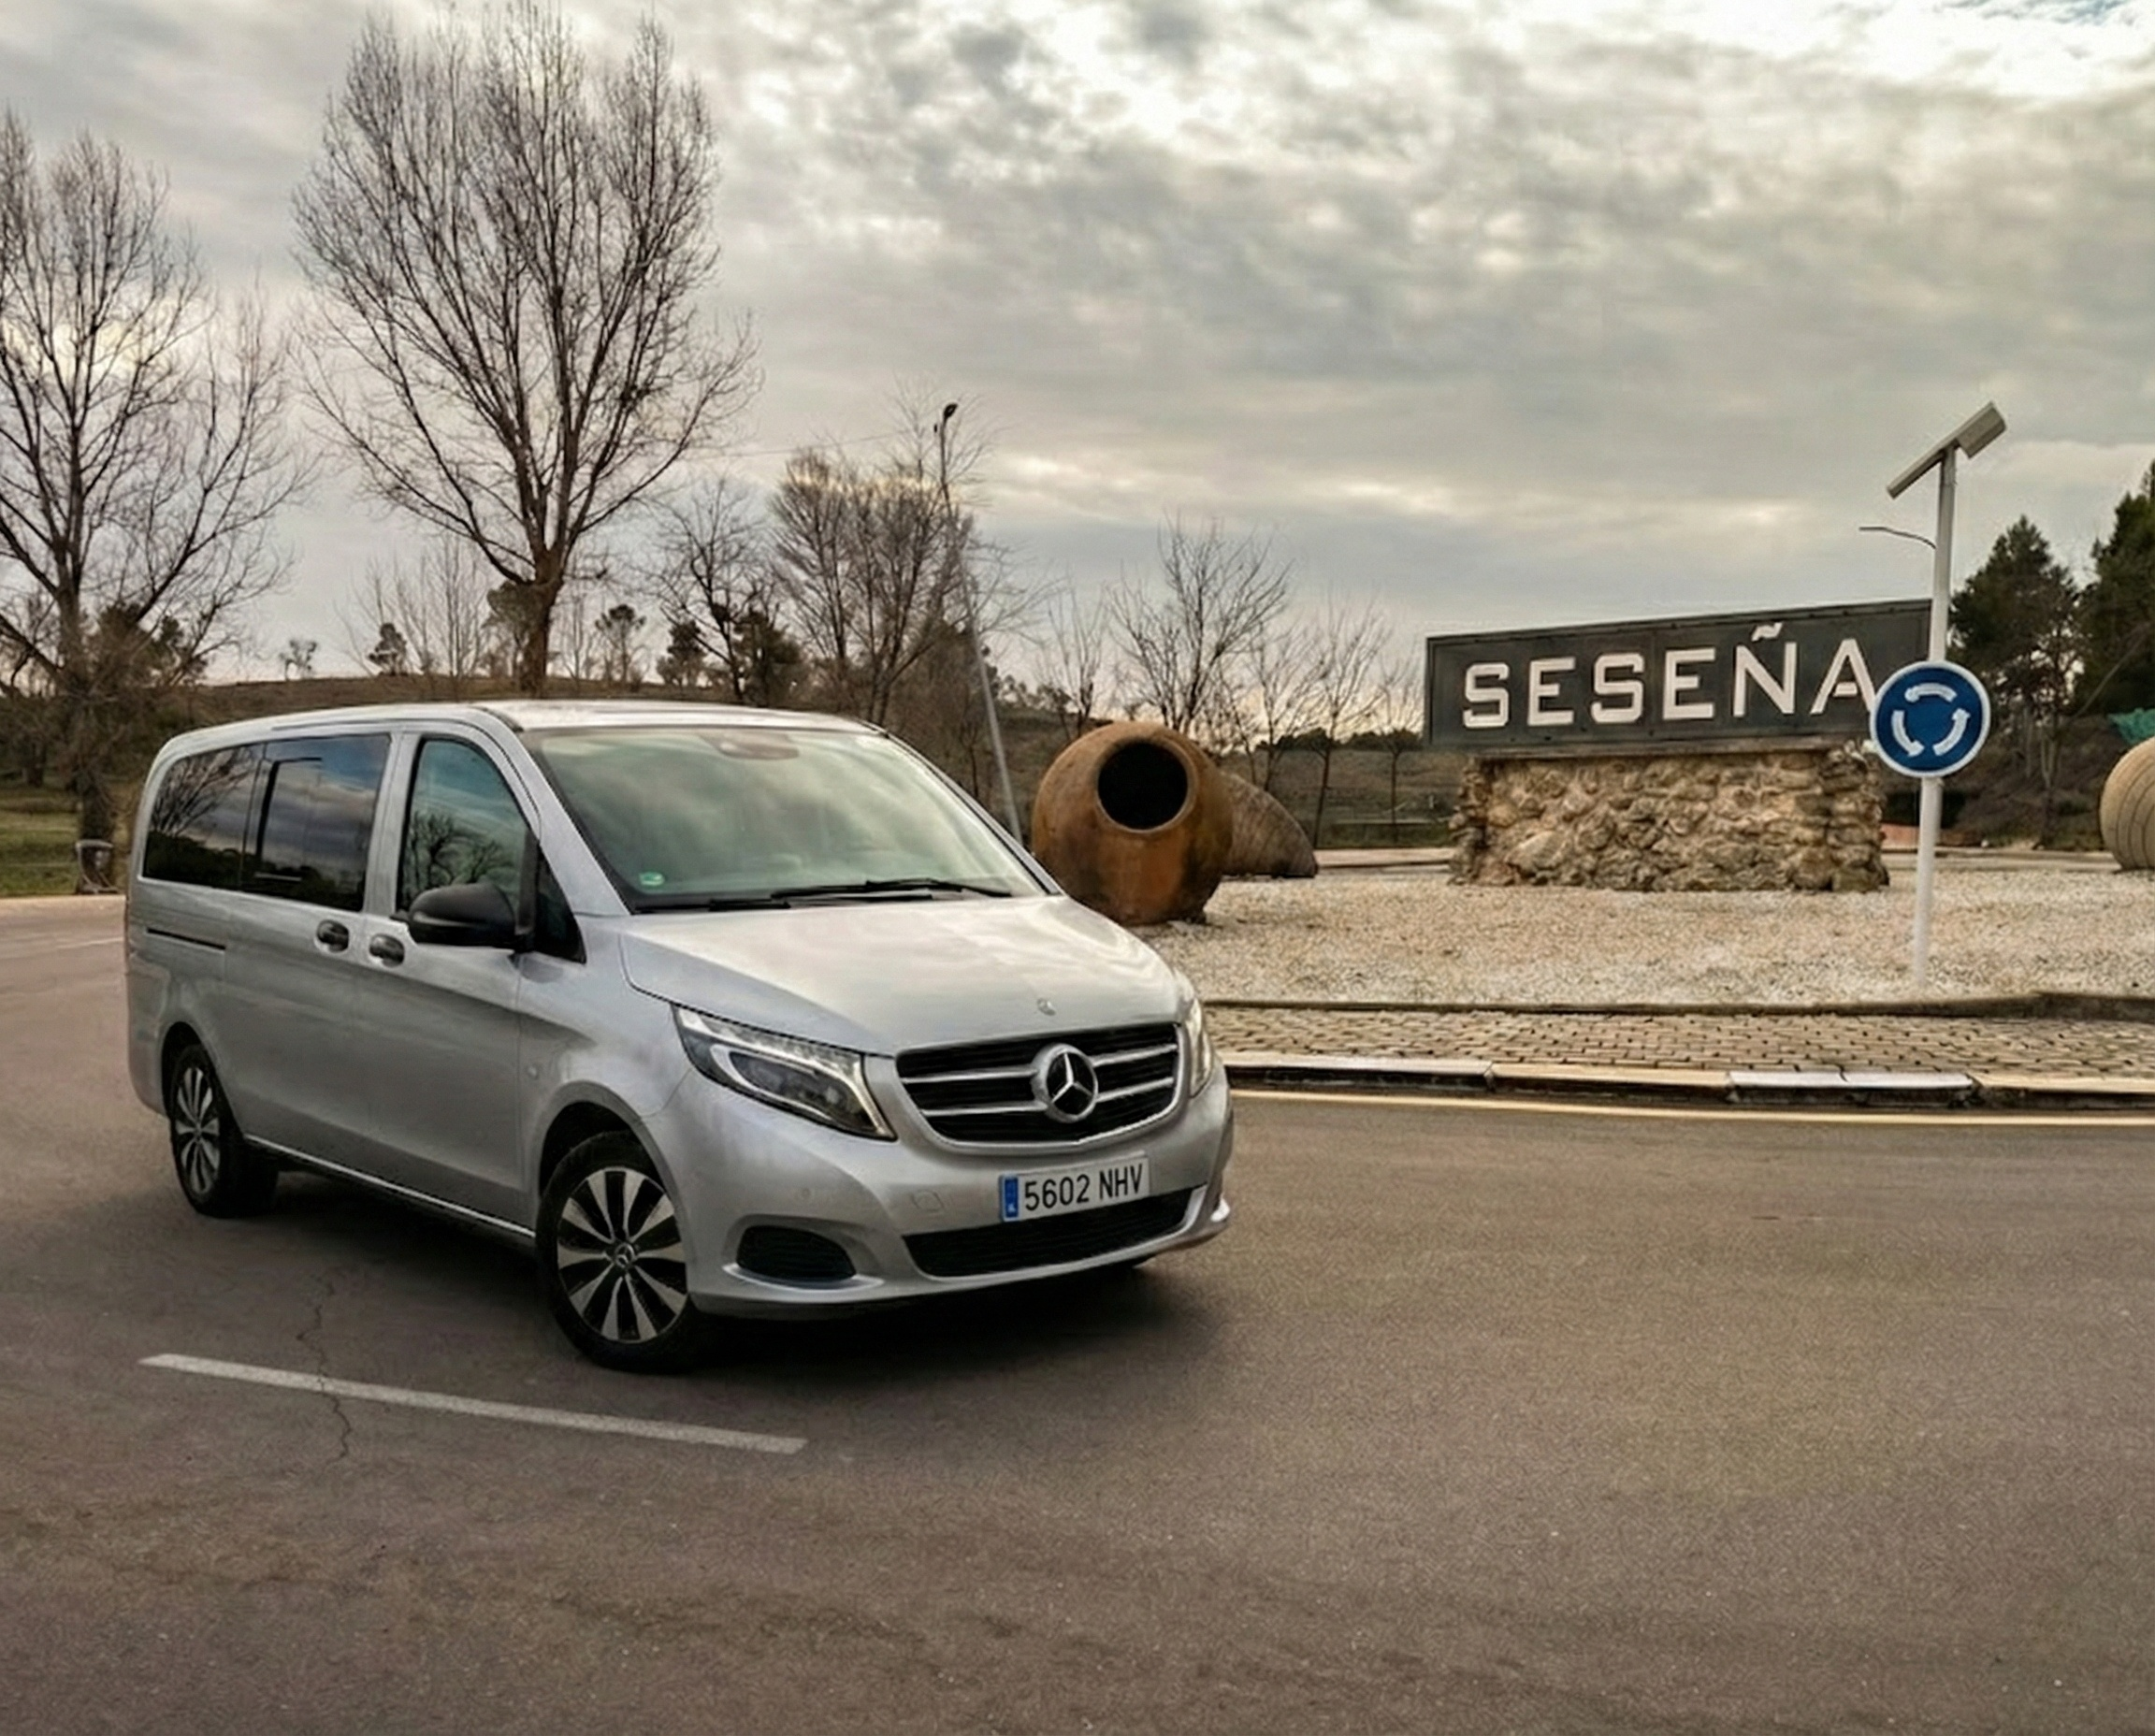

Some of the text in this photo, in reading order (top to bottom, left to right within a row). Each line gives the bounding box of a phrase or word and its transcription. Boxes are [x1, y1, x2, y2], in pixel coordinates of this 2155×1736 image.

[1463, 622, 1876, 729] SESEÑA
[1024, 1164, 1143, 1210] 5602 NHV
